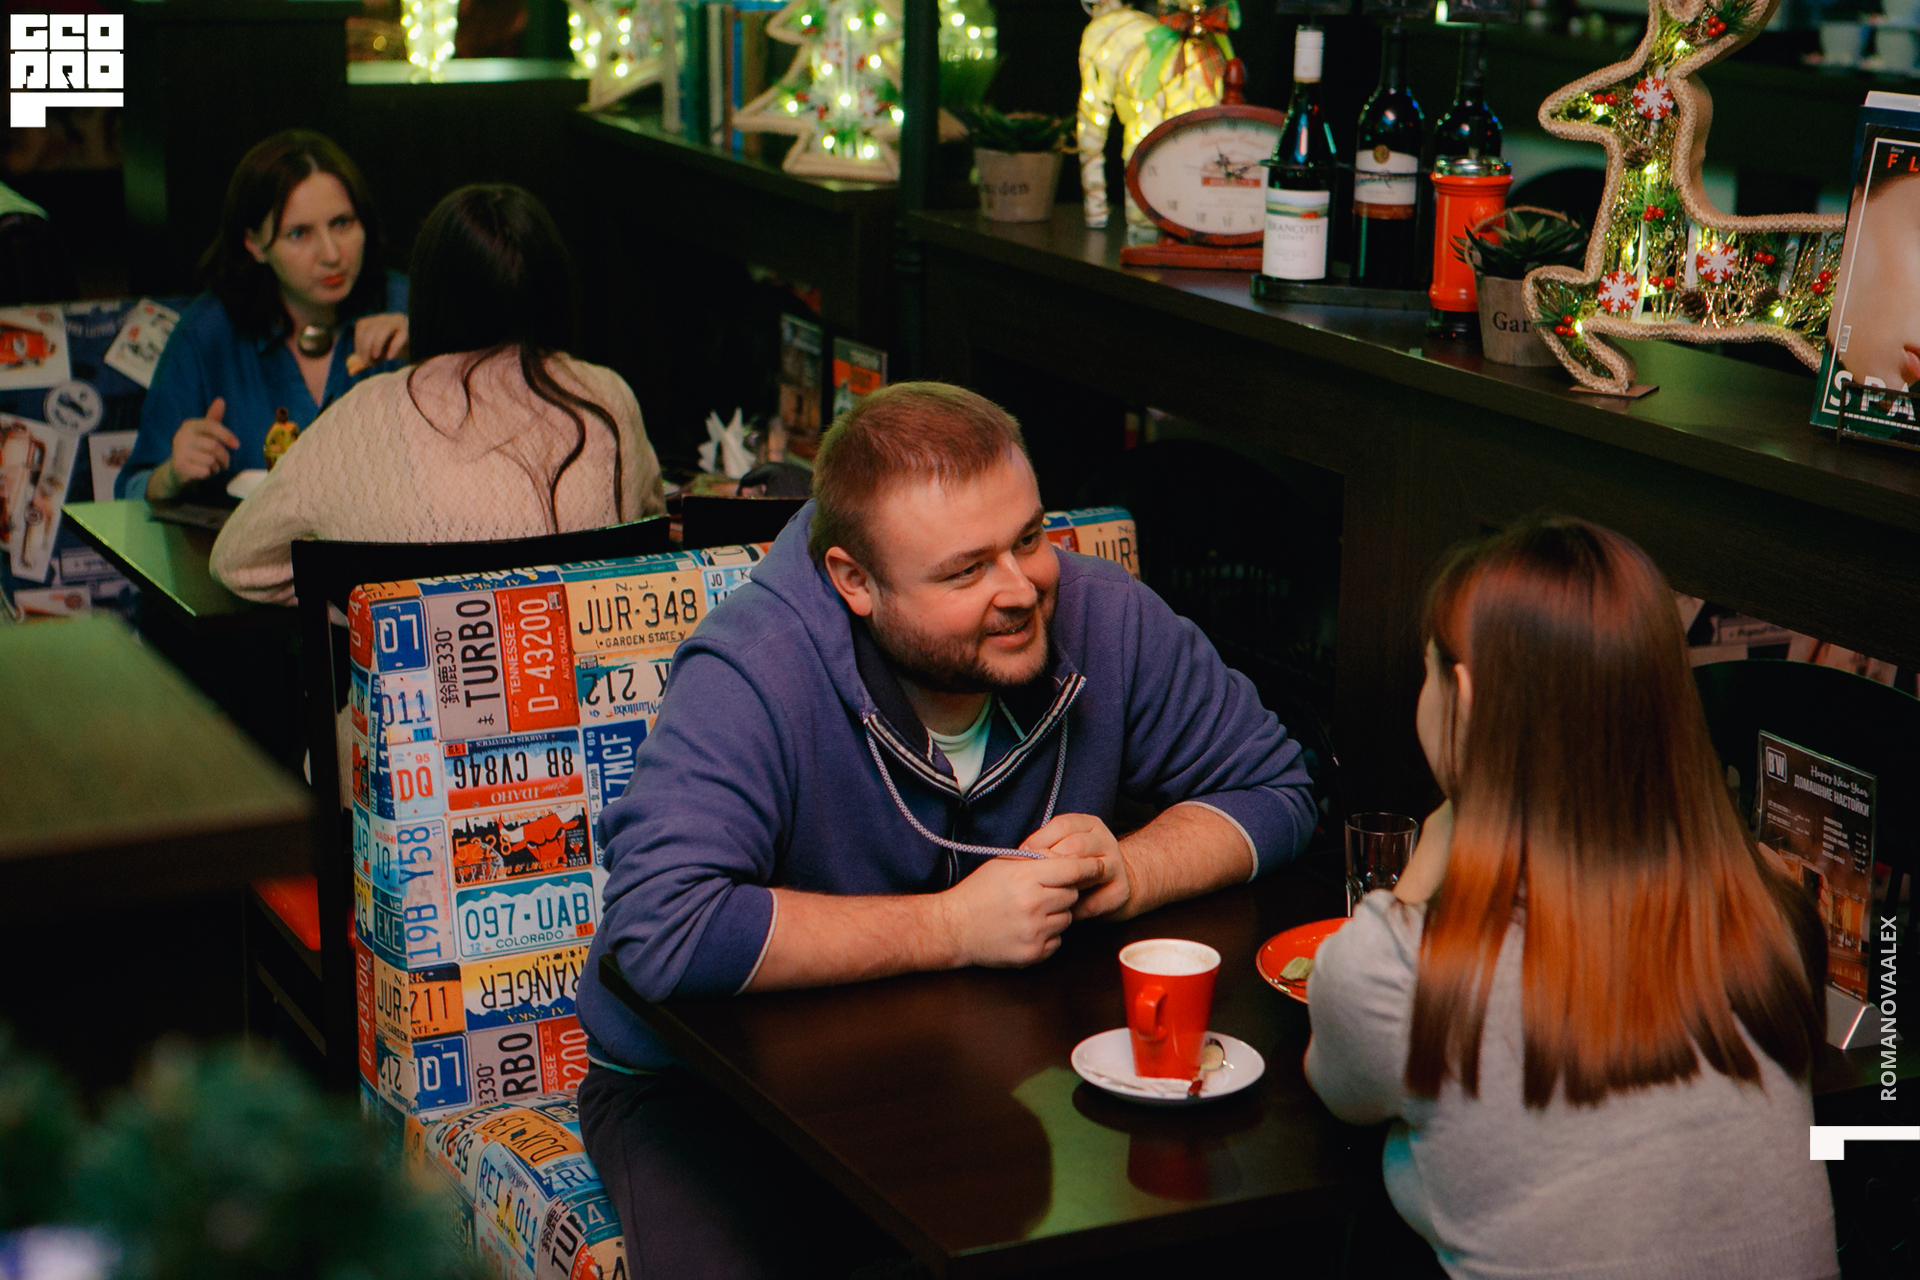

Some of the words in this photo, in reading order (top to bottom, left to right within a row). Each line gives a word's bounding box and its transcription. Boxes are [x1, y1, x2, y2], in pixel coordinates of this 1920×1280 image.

[558, 625, 569, 654] DEALER
[604, 633, 646, 648] GARDEN
[647, 630, 678, 644] STATE
[456, 599, 501, 708] TURBO
[503, 621, 522, 696] TENNESSEE
[518, 597, 560, 713] D-43200
[560, 658, 570, 680] AUTO
[582, 667, 637, 706] 212
[613, 701, 663, 715] Manitoba
[475, 736, 516, 747] POTATOES
[516, 733, 548, 744] FAMOUS
[415, 753, 431, 764] 95
[453, 751, 528, 790] CV846
[546, 746, 574, 778] 8B
[396, 765, 434, 801] DQ
[589, 768, 600, 790] Joseph
[1810, 764, 1833, 785] Happy
[1833, 774, 1850, 789] New
[1850, 782, 1870, 798] Year
[490, 786, 540, 804] IDAHO
[1794, 774, 1834, 802] ДОМАШНИЕ
[1833, 790, 1870, 818] НАСТОЙКИ
[397, 826, 435, 885] Y58
[568, 856, 588, 867] 12/31
[495, 930, 564, 949] COLORADO
[577, 925, 589, 935] 11
